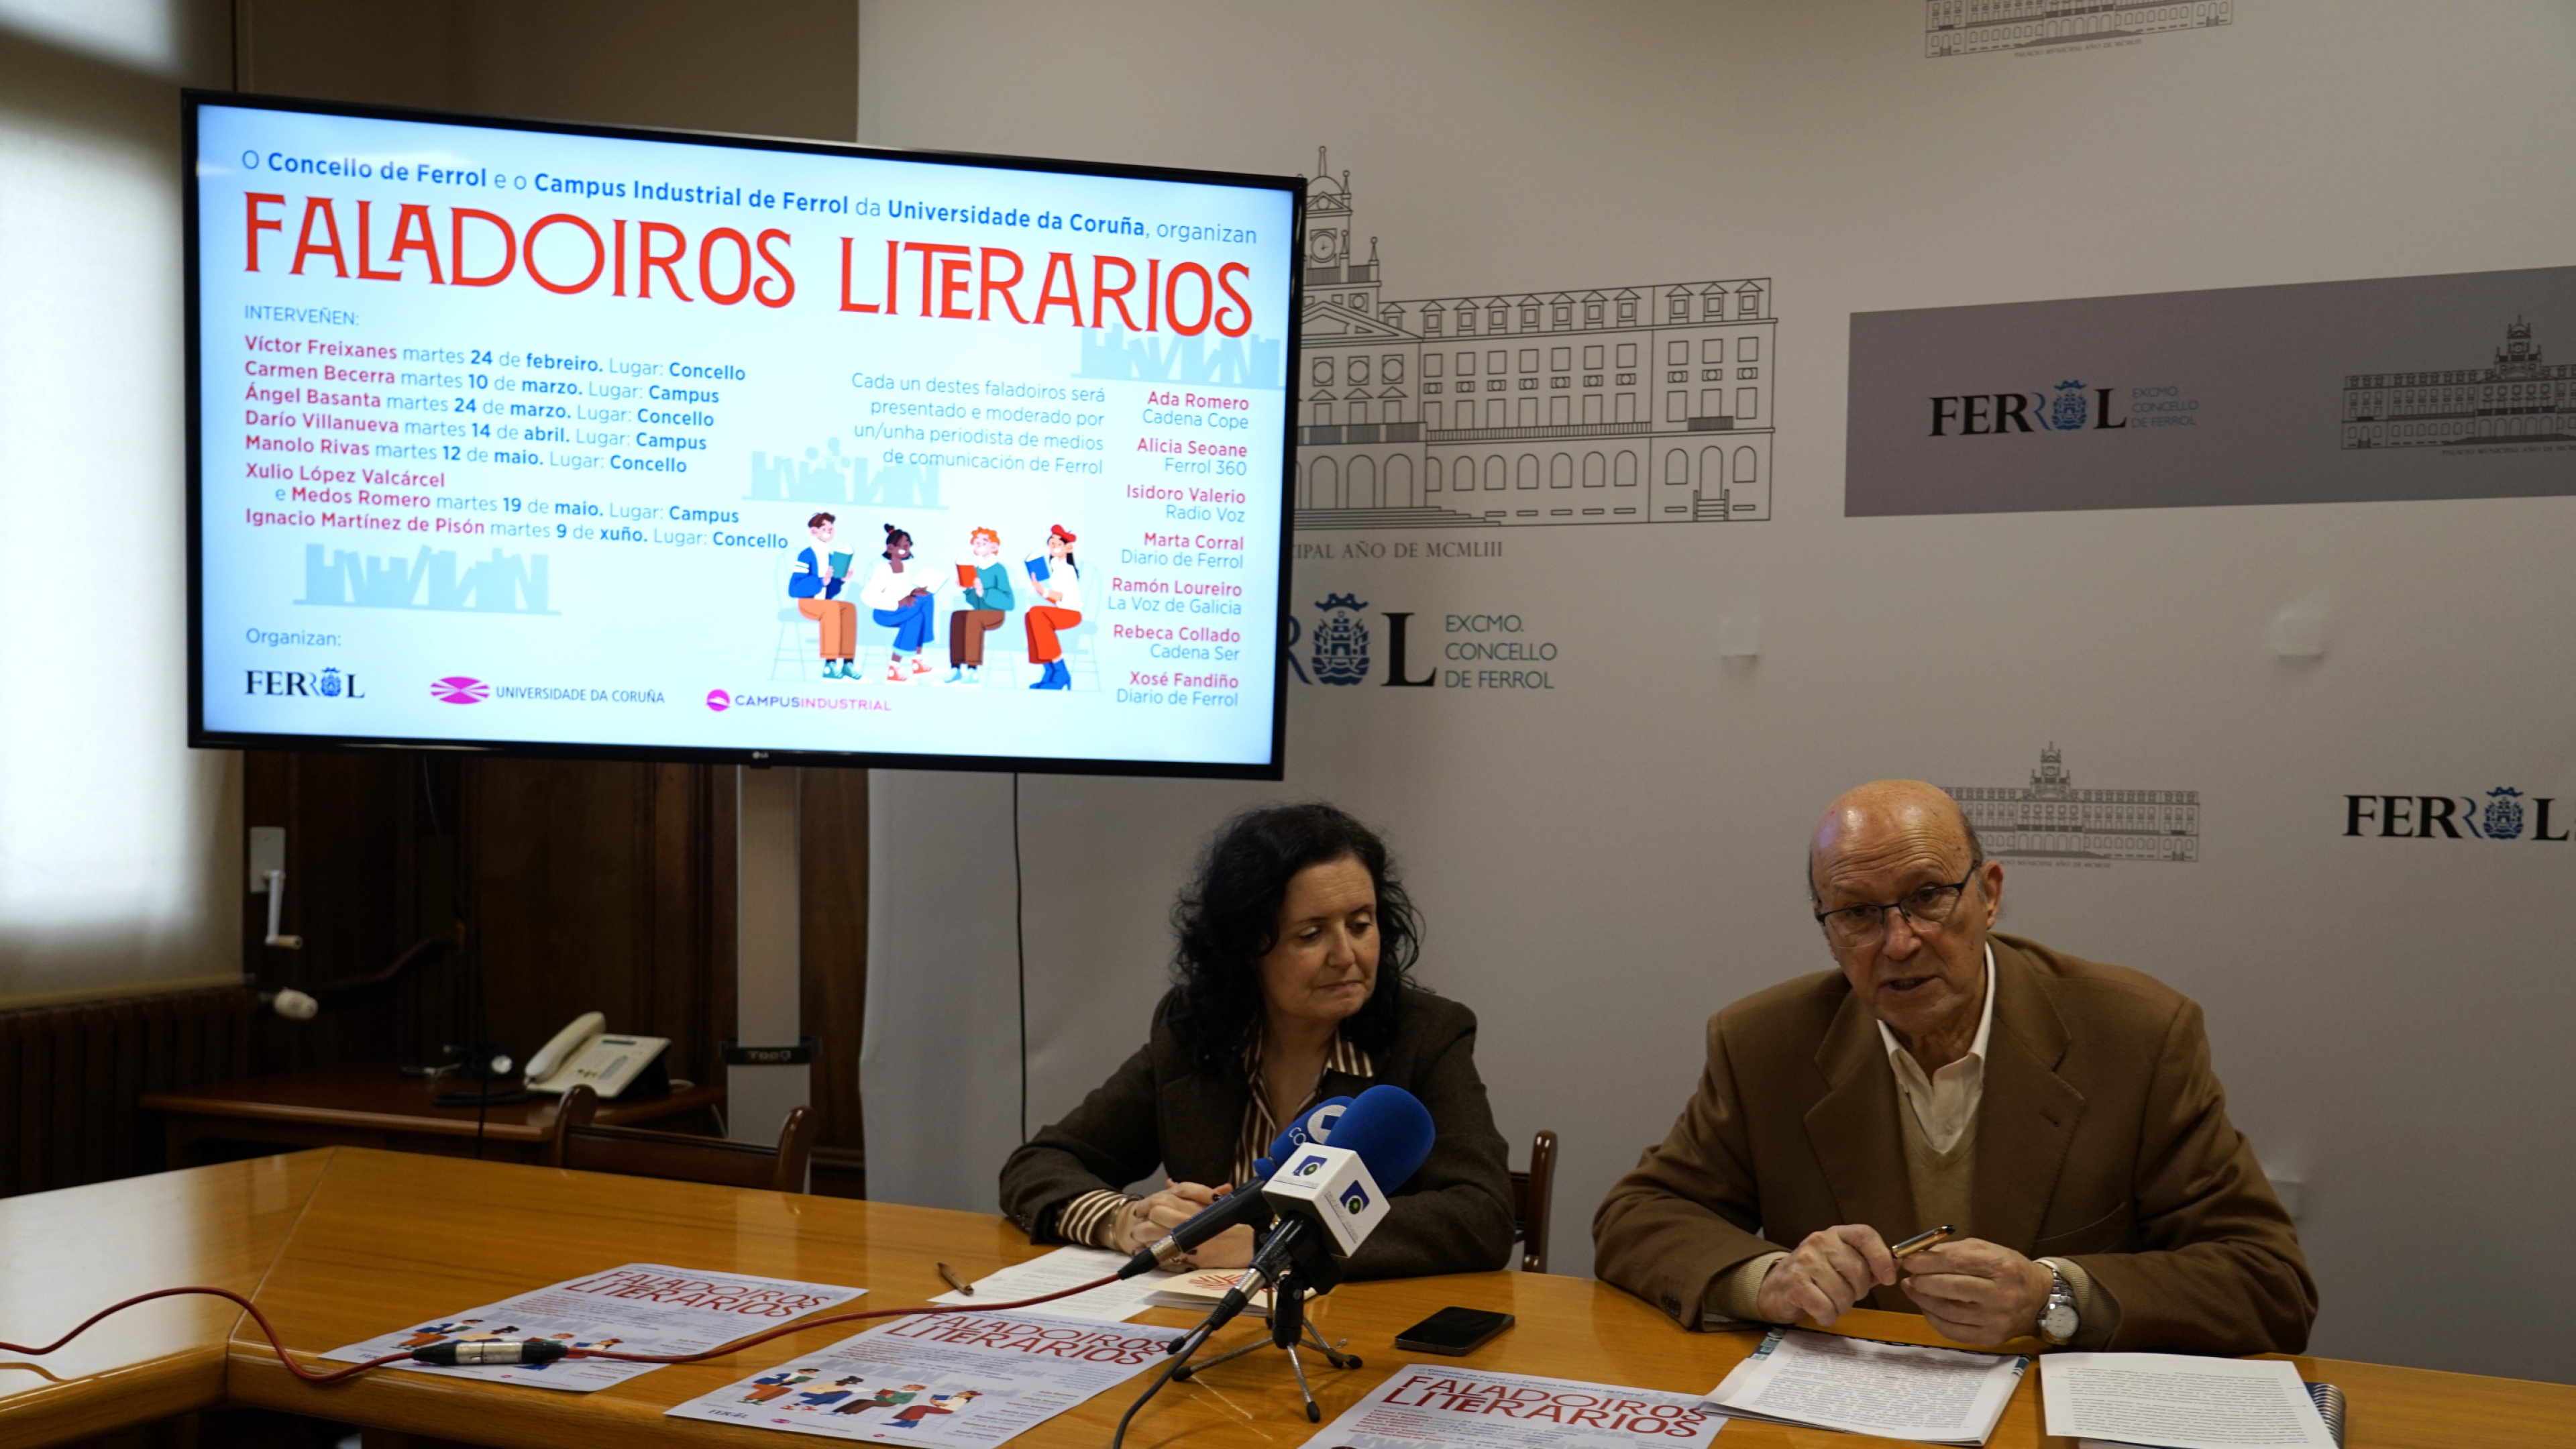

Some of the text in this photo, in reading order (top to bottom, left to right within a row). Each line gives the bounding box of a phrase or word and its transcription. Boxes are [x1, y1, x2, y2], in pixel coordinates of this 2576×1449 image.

[243, 150, 1256, 244] O Concello de Ferrol e o Campus Industrial de Ferrol da Universidade da Coruña, organizan
[243, 191, 1253, 338] FALADOIROS LITERARIOS
[244, 305, 360, 326] INTERVEÑEN:
[246, 336, 746, 381] Víctor Freixanes martes 24 de febreiro. Lugar: Concello
[245, 360, 720, 405] Carmen Becerra martes 10 de marzo. Lugar: Campus
[851, 372, 1106, 402] Cada un destes faladoiros será
[246, 385, 714, 427] Ángel Basanta martes 24 de marzo. Lugar: Concello
[1147, 390, 1249, 411] Ada Romero
[2132, 400, 2200, 413] CONCELLO
[870, 401, 1105, 428] presentado e moderado por
[1142, 408, 1249, 431] Cadena Cope
[2131, 415, 2197, 428] DE FERROL
[246, 410, 707, 452] Darío Villanueva martes 14 de abril. Lugar: Campus
[854, 421, 1104, 451] un/unha periodista de medios
[246, 435, 688, 474] Manolo Rivas martes 12 de maio. Lugar: Concello
[1137, 437, 1247, 458] Alicia Seoane
[882, 447, 1103, 475] de comunicación de Ferrol
[1165, 457, 1247, 476] Ferrol 360
[246, 462, 445, 488] Xulio López Valcárcel
[275, 486, 740, 525] e Medos Romero martes 19 de maio. Lugar: Campus
[1127, 484, 1246, 504] Isidoro Valerio
[1165, 504, 1246, 523] Radio Voz
[247, 508, 789, 549] Ignacio Martínez de Pisón martes 9 de xuño. Lugar: Concello
[1144, 532, 1243, 550] Marta Corral
[1343, 541, 1385, 559] AÑO
[1395, 543, 1419, 558] DE
[1426, 541, 1503, 558] MCMLIII
[1112, 577, 1242, 597] Ramón Loureiro
[1107, 595, 1242, 616] La Voz de Galicia
[1114, 624, 1240, 643] Rebeca Collado
[1444, 614, 1525, 633] EXCMO.
[245, 627, 341, 648] Organizan:
[1149, 643, 1241, 661] Cadena Ser
[1444, 642, 1558, 661] CONCELLO
[1130, 671, 1238, 689] Xosé Fandiño
[1444, 670, 1555, 690] DE FERROL
[496, 686, 665, 704] UNIVERSIDADE DA CORUÑA
[565, 1279, 806, 1318] LITERARIOS
[597, 1271, 832, 1308] FALADOIROS
[883, 1322, 1155, 1365] LITERARIOS
[914, 1311, 1174, 1353] FALADOIROS
[1400, 1375, 1709, 1423] FALADOIROS
[1380, 1387, 1702, 1438] LITERARIOS
